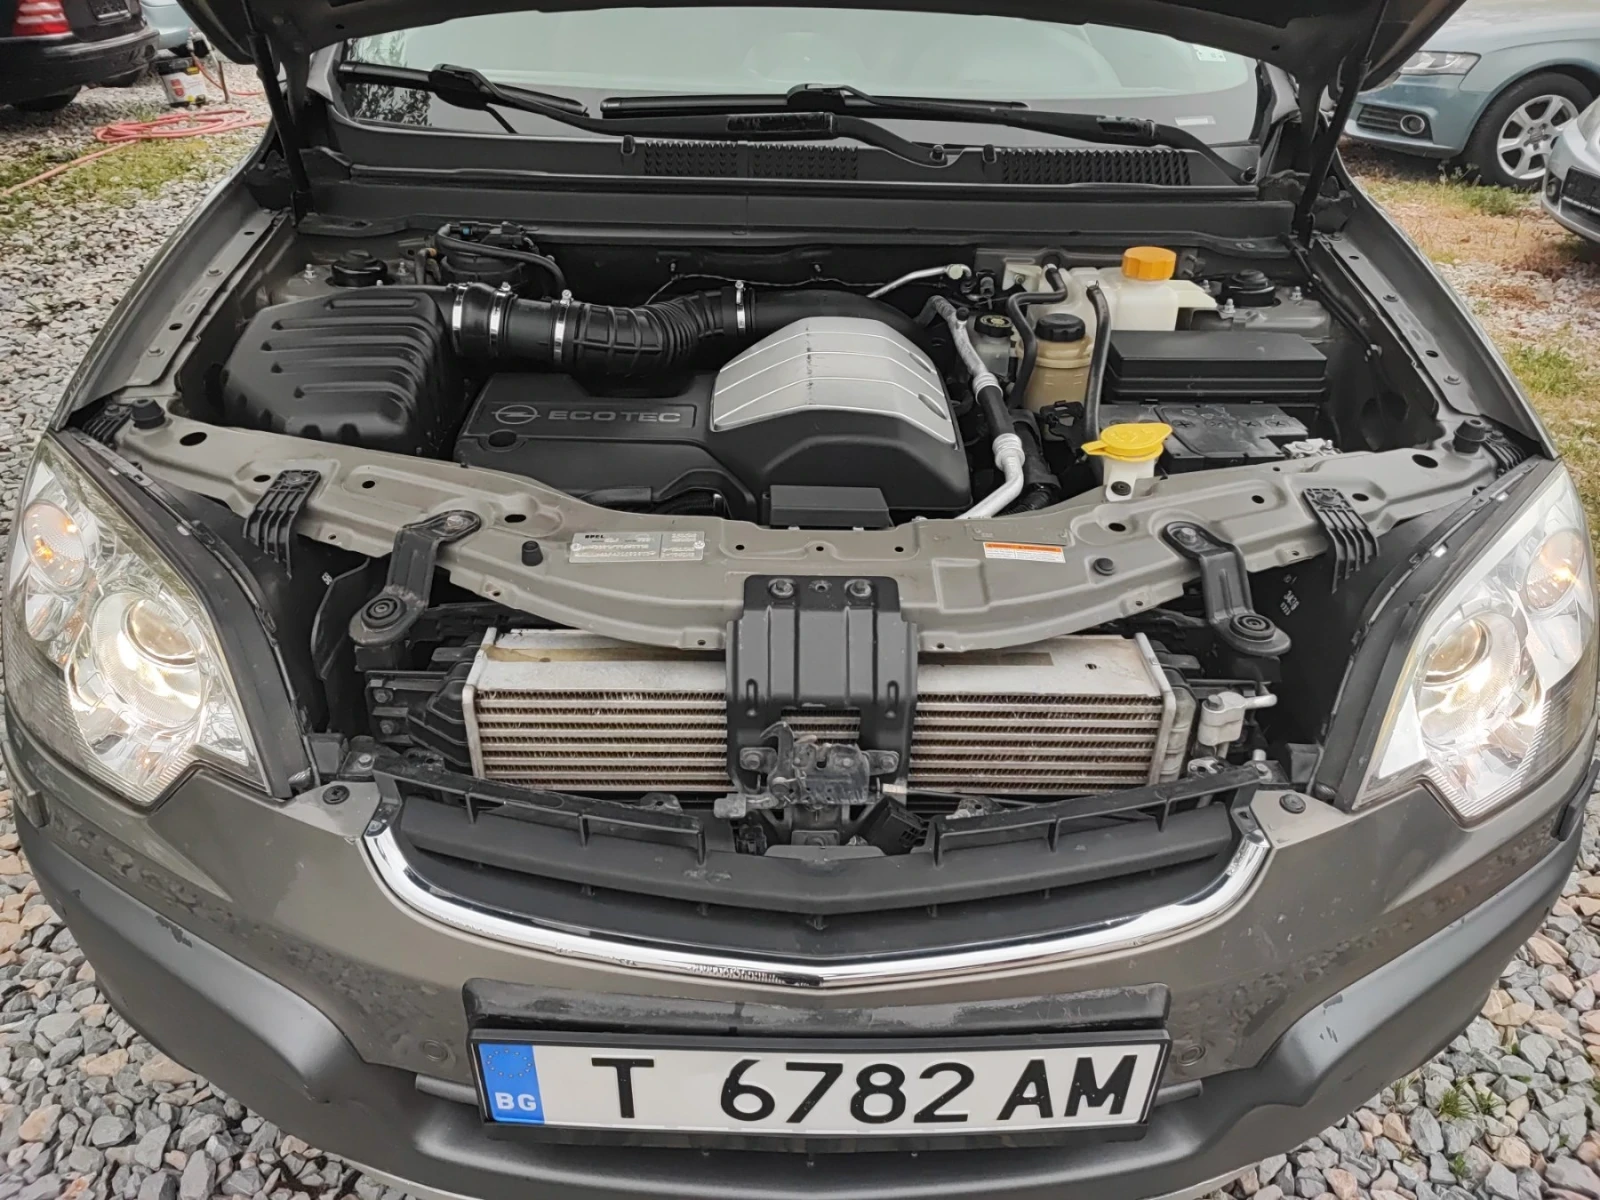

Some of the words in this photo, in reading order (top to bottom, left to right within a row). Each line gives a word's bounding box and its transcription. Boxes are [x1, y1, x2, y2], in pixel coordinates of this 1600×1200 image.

[548, 410, 681, 423] ECOTEC
[591, 1057, 655, 1119] T
[720, 1059, 975, 1123] 6782
[996, 1055, 1138, 1120] AM
[495, 1091, 537, 1112] BG
